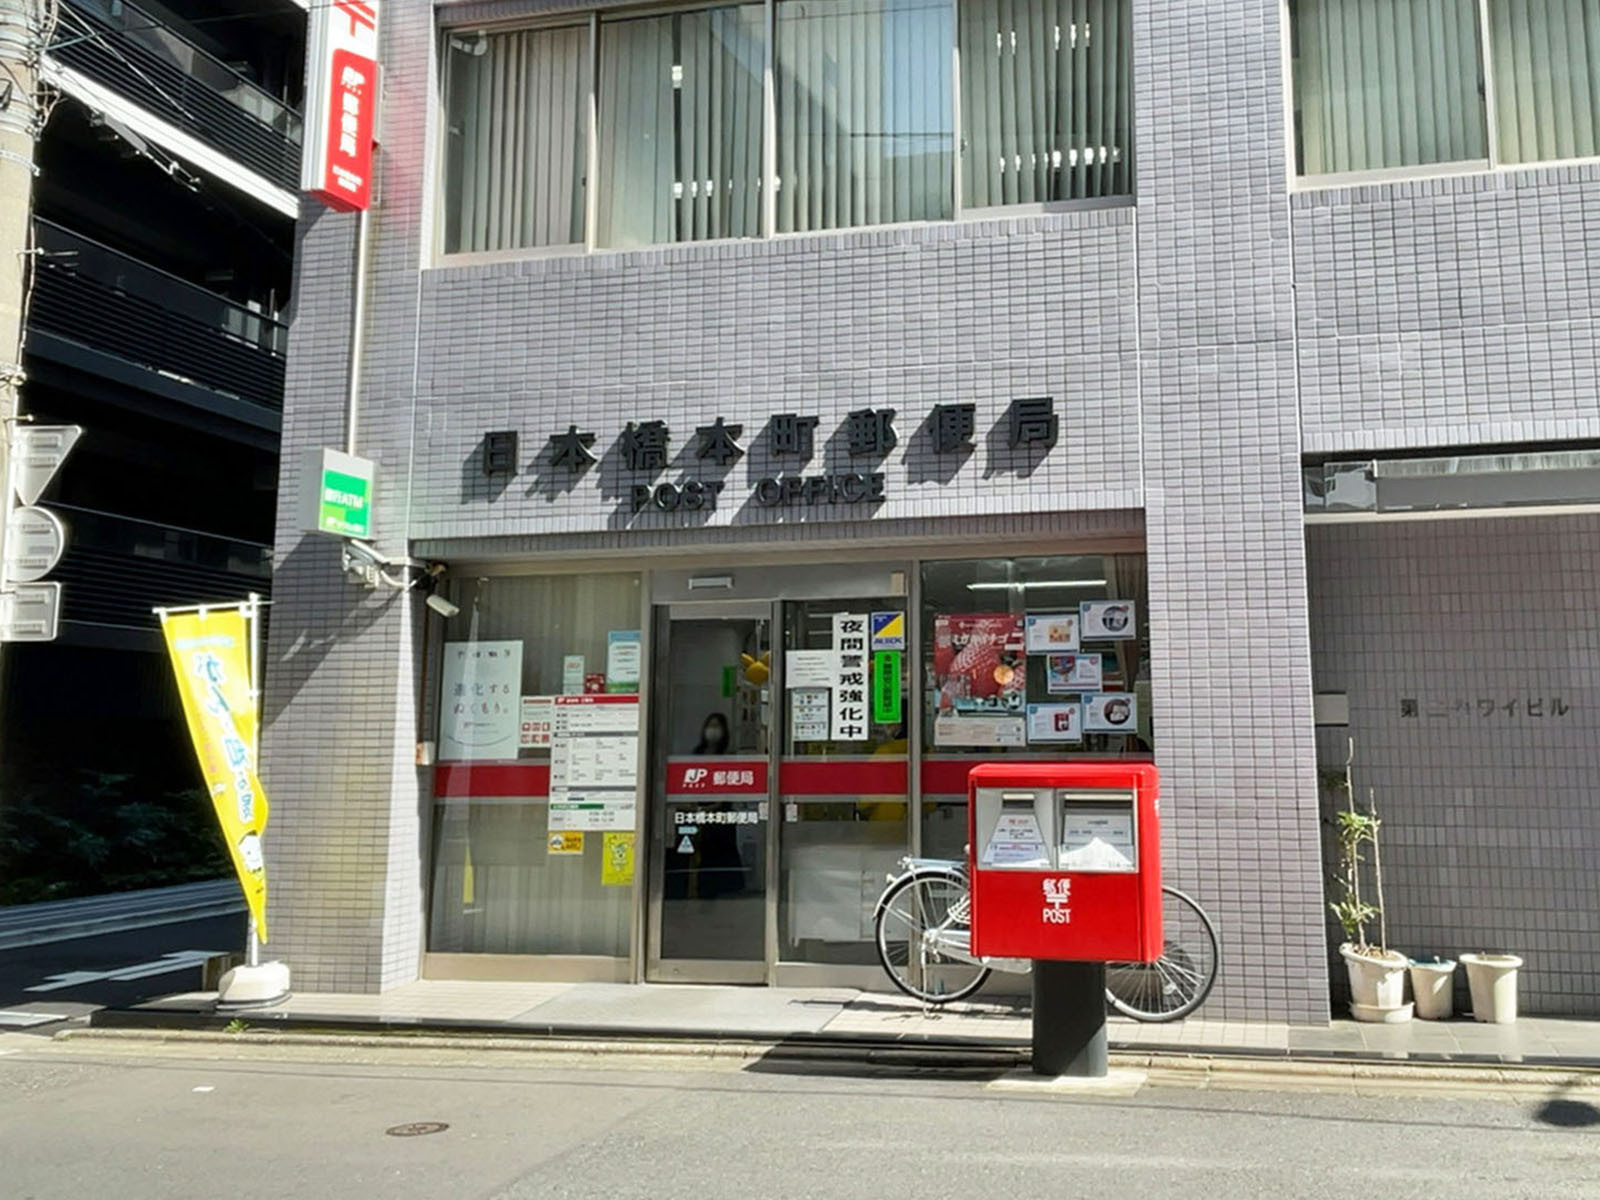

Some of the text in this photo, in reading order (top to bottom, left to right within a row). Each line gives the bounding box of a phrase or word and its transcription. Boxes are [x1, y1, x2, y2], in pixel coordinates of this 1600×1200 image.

[482, 396, 1059, 477] 日本橋本町郵便局
[631, 471, 887, 512] POST OFFICE
[839, 619, 864, 738] 夜間警戒強化中
[713, 770, 754, 786] 郵便局
[674, 810, 758, 825] 日本橋本町郵便局
[1042, 878, 1071, 897] 郵便
[1042, 908, 1071, 924] POST
